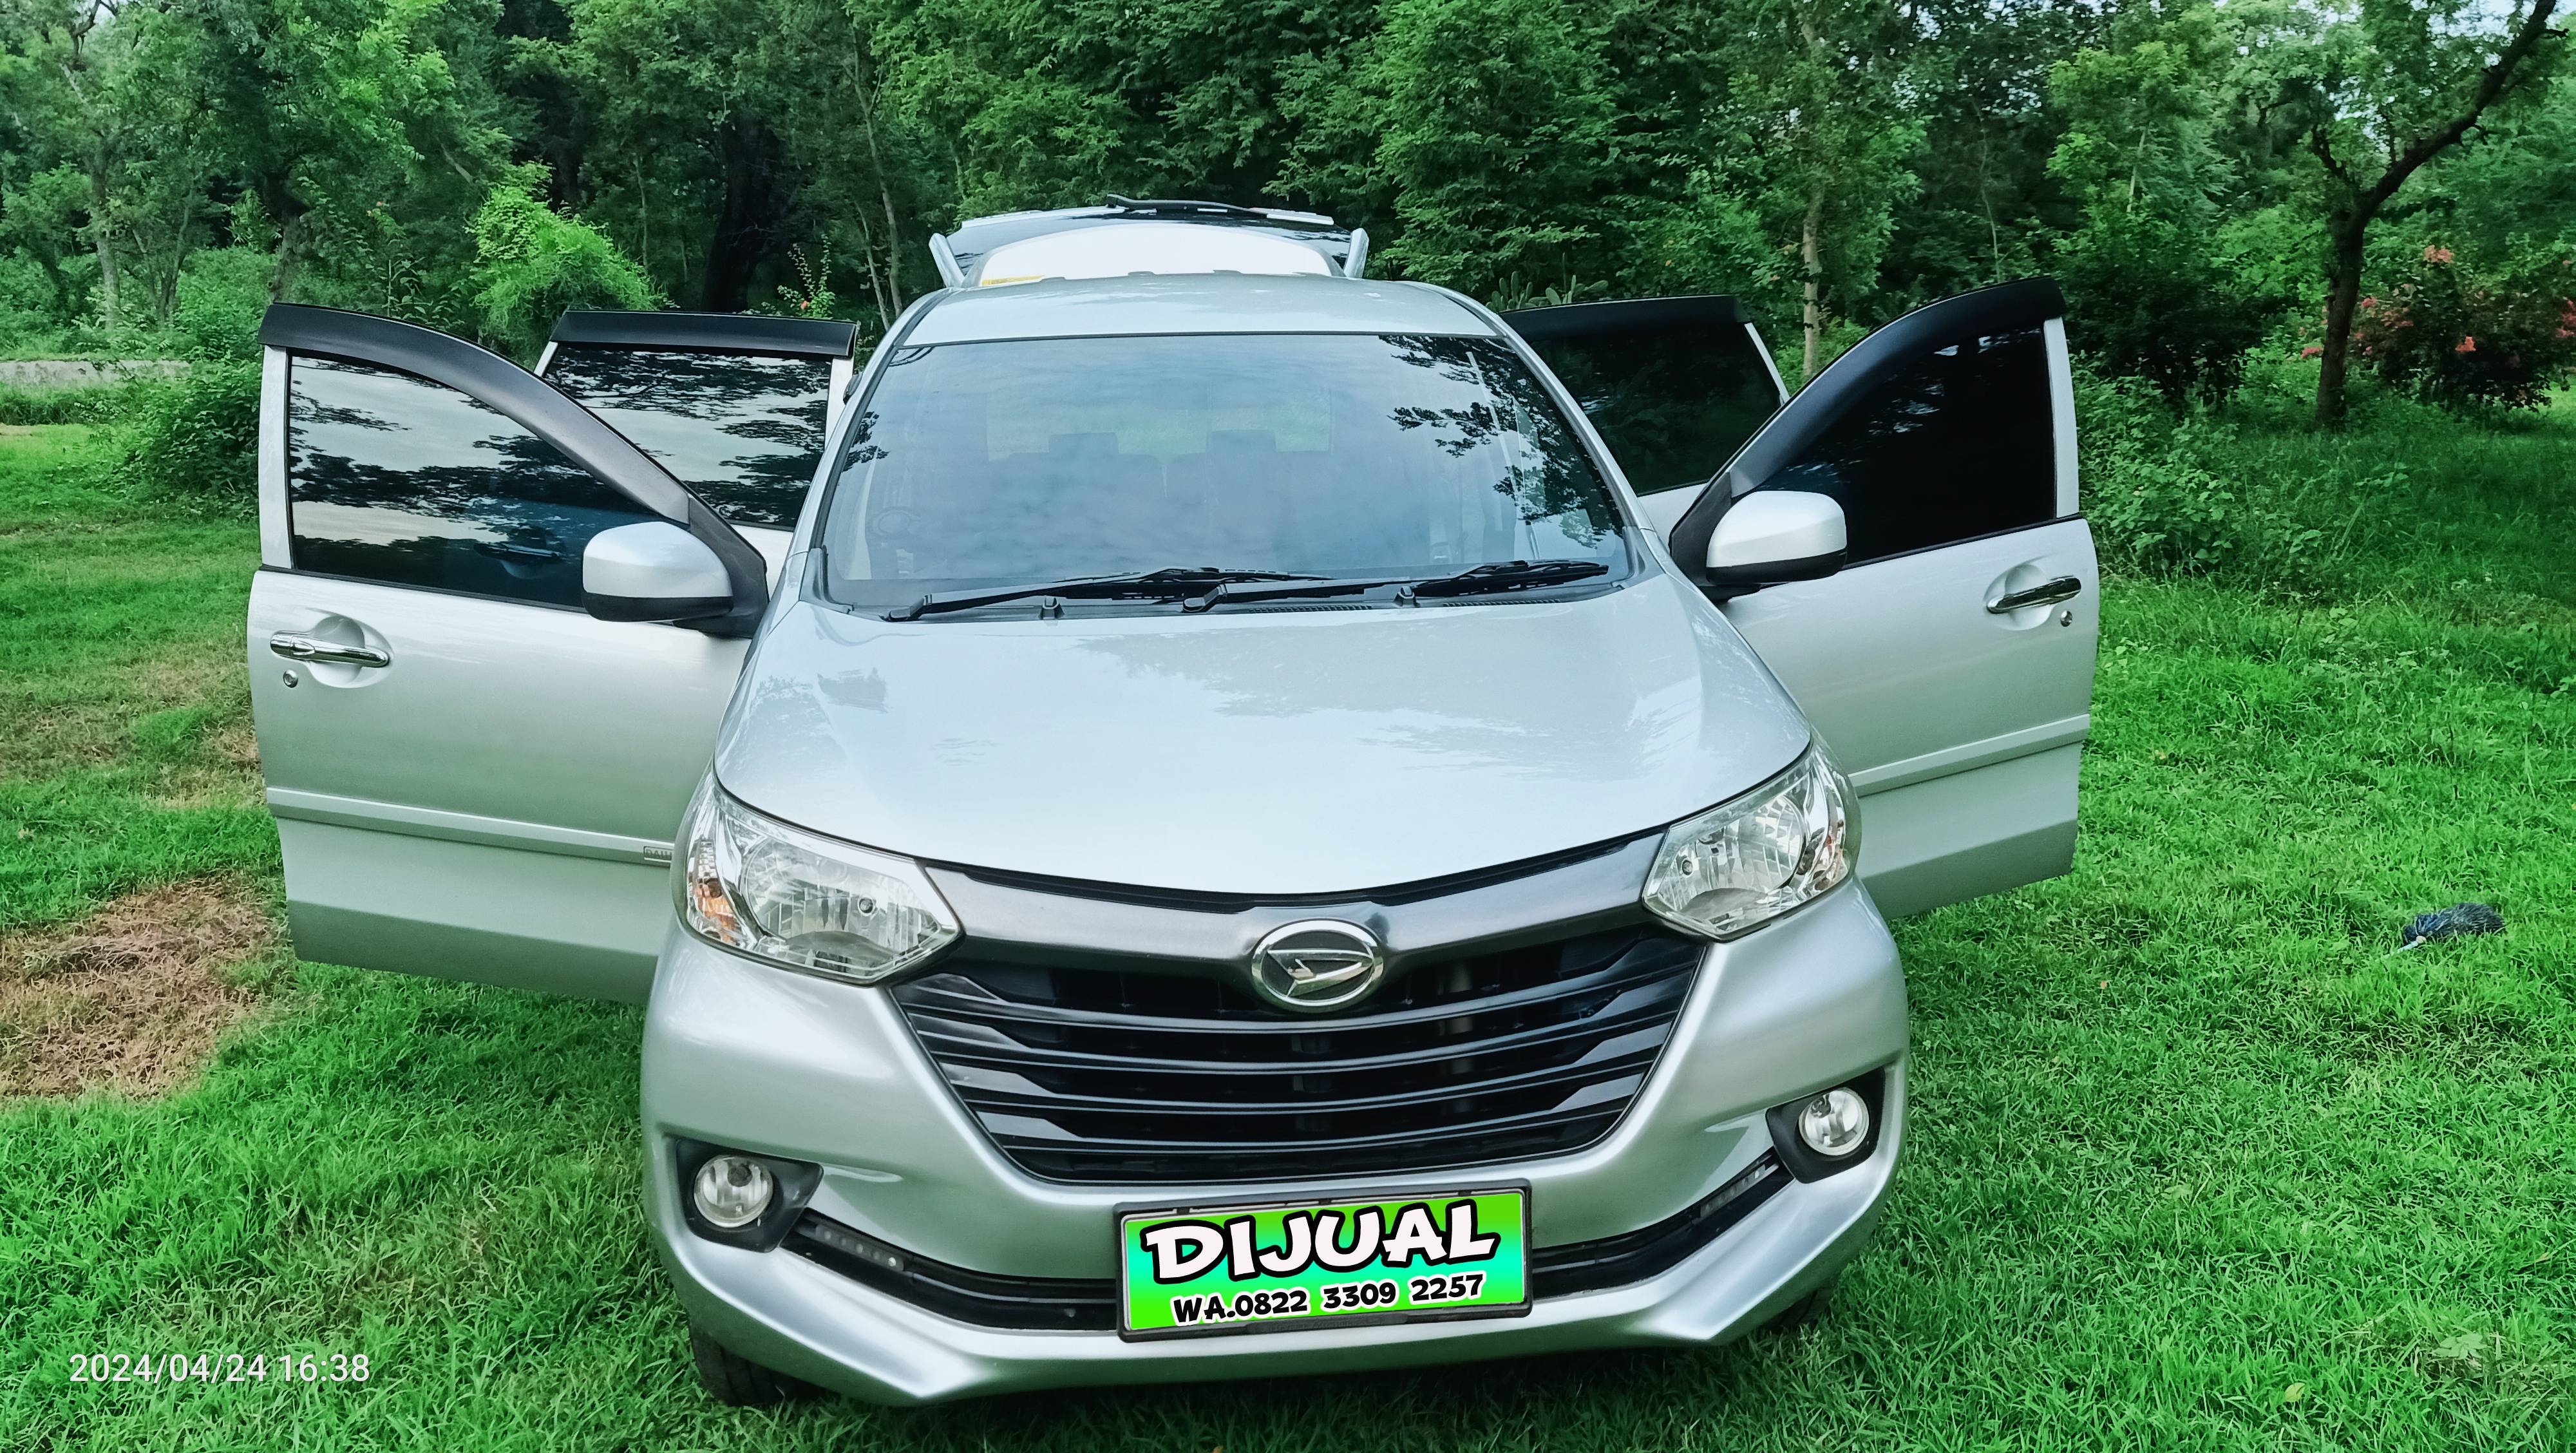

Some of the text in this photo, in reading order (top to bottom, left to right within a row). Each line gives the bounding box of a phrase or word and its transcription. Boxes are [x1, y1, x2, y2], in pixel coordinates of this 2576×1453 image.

[1143, 1202, 1498, 1281] DIJUAL
[1173, 1273, 1484, 1324] WA.0822 3309 2257
